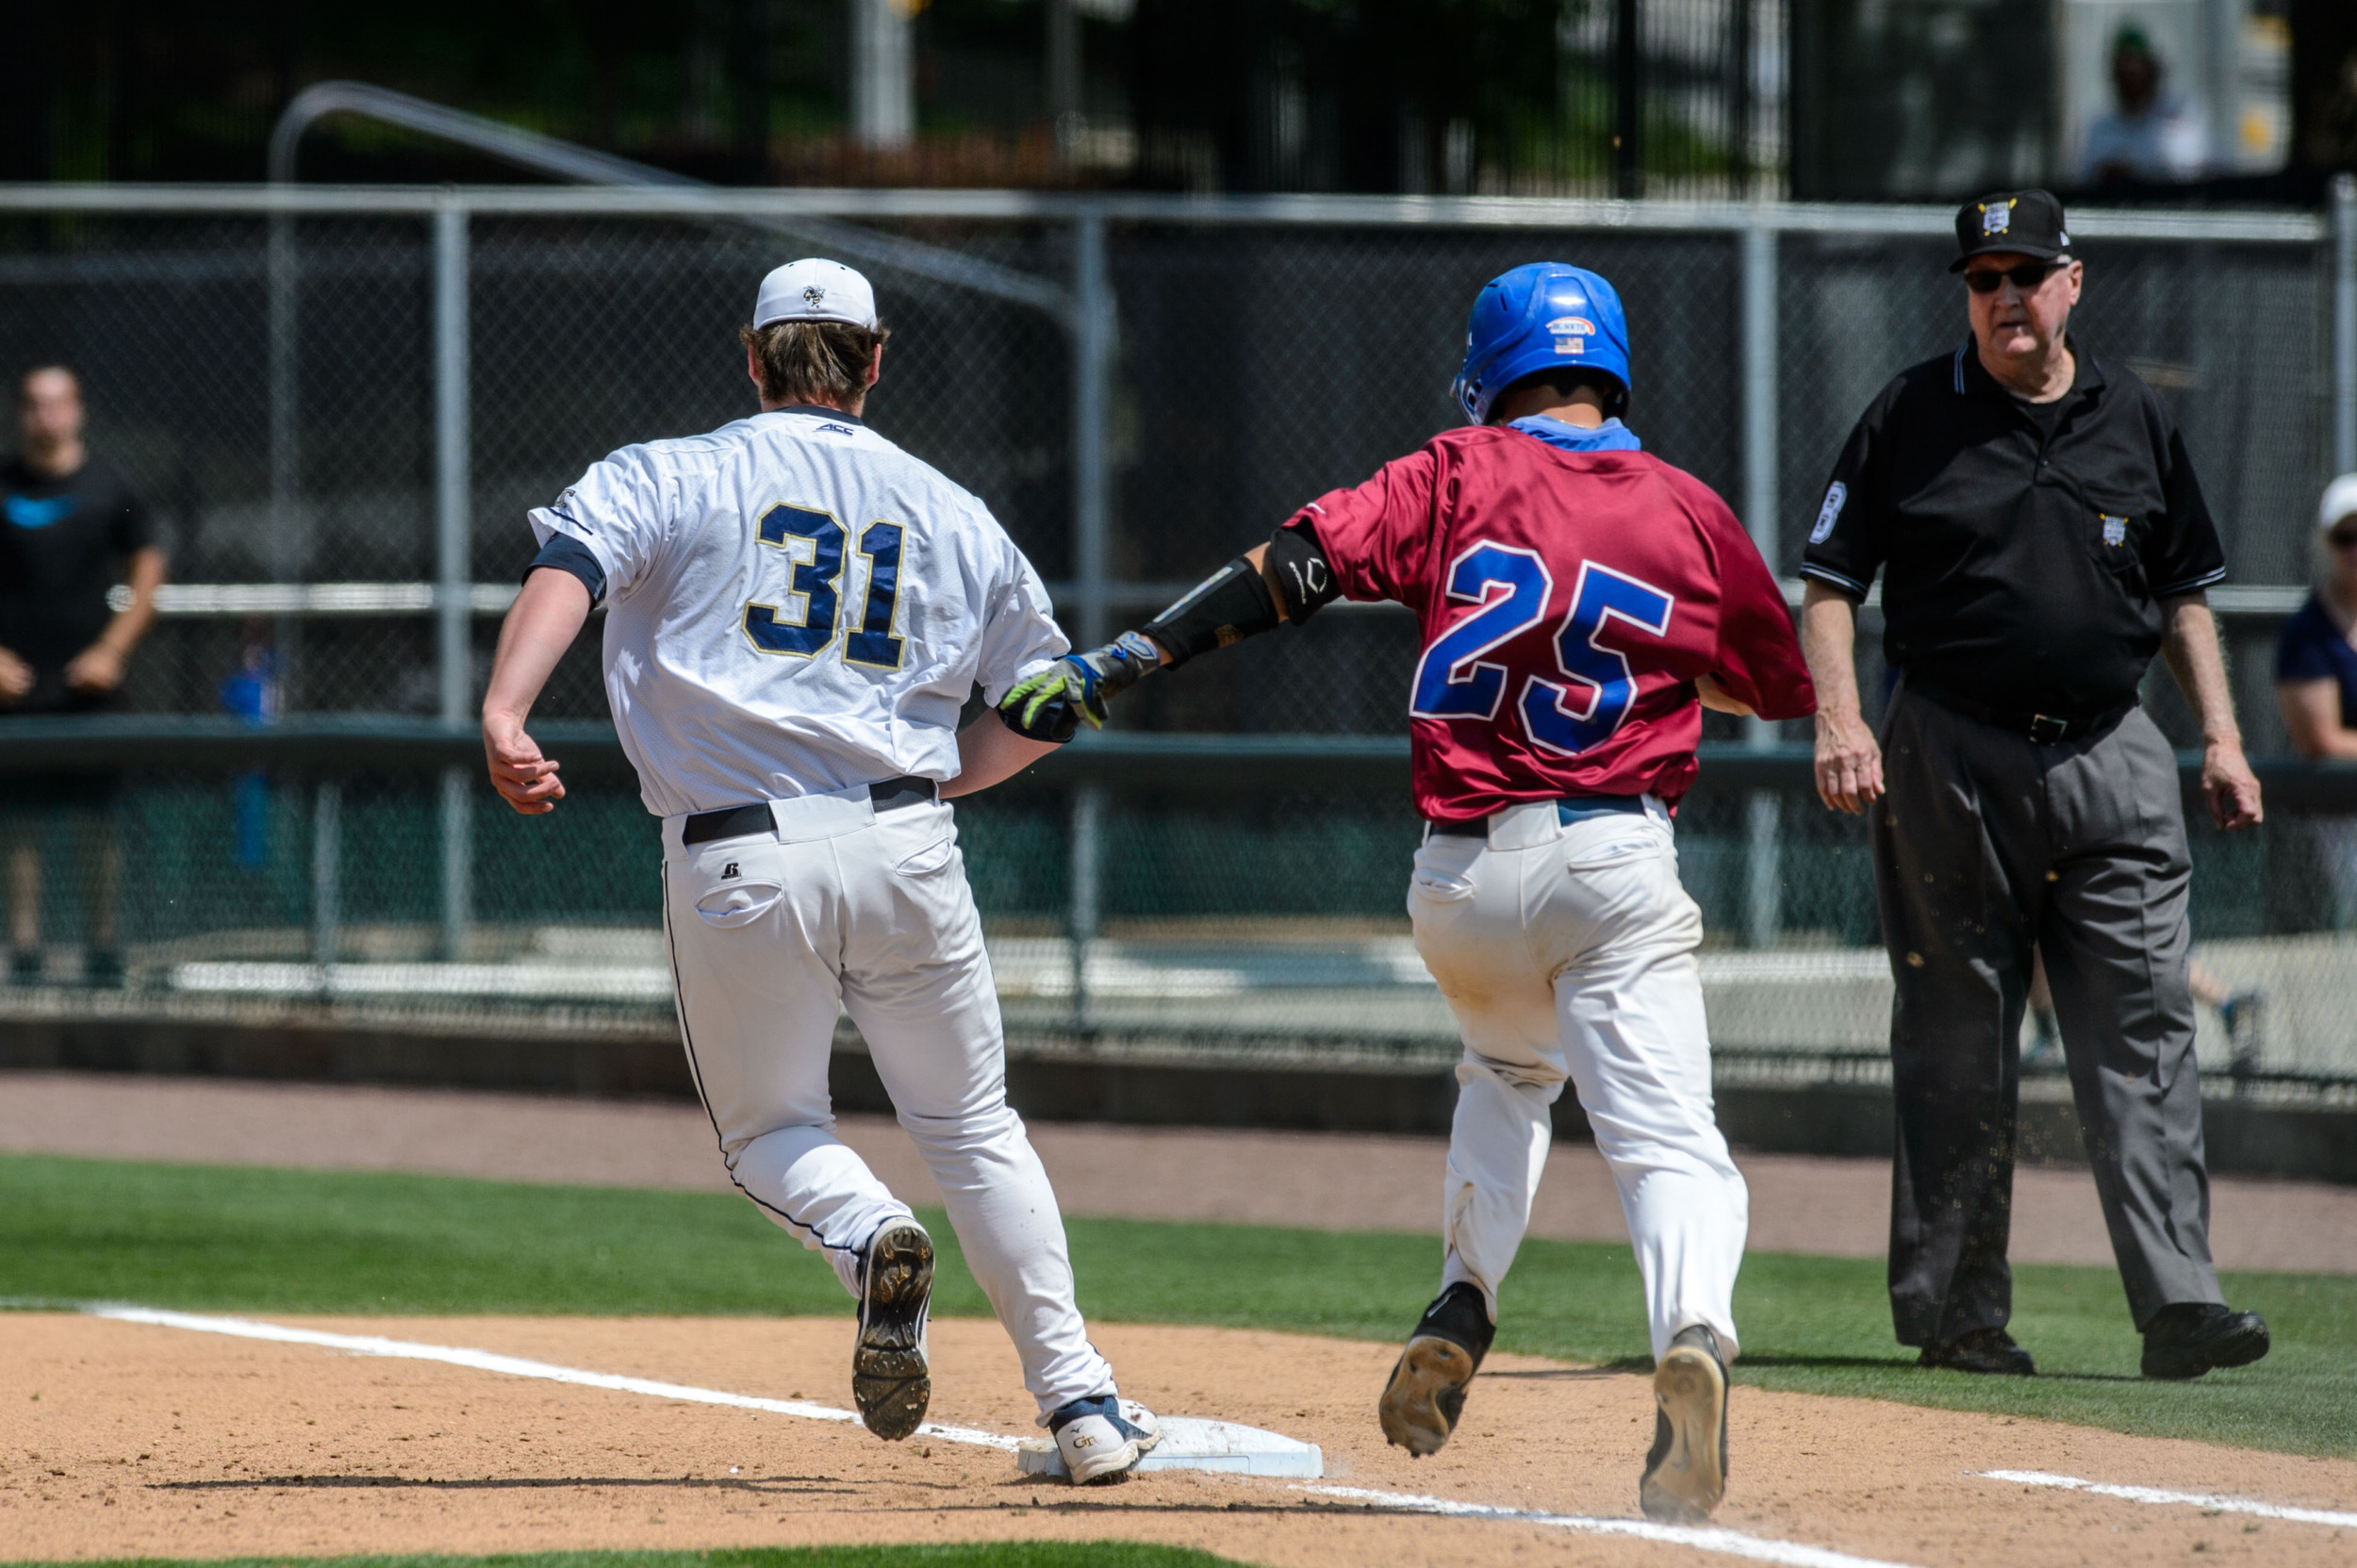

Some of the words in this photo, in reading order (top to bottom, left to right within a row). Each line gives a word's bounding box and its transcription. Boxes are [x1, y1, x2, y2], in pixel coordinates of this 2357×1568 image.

[816, 423, 854, 436] ACC
[742, 501, 907, 671] 31
[1409, 538, 1675, 757] 25
